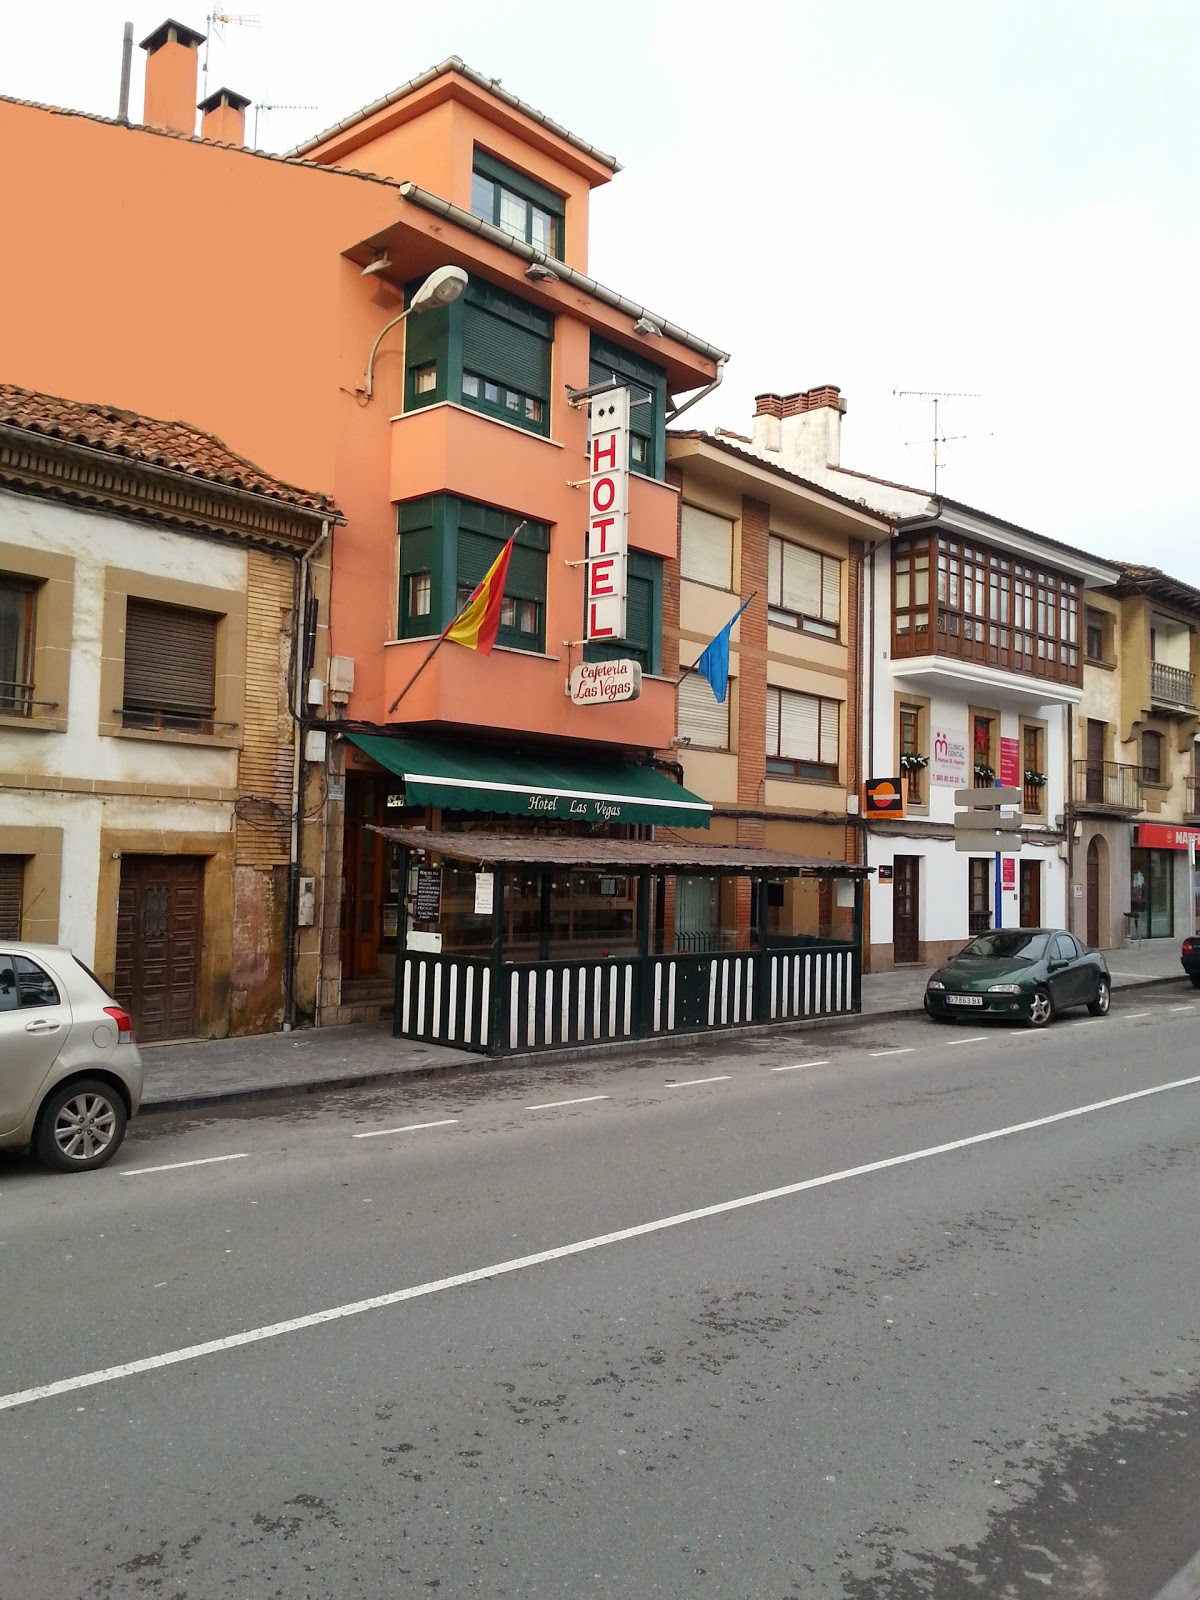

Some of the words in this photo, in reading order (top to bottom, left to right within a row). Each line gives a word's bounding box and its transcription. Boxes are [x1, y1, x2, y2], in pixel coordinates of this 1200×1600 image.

[591, 435, 616, 637] HOTEL
[581, 664, 627, 683] Cafeteria
[574, 680, 597, 698] Las
[600, 676, 630, 700] Vegas
[948, 750, 964, 758] DENTAL
[528, 796, 558, 810] Hotel
[569, 800, 587, 813] Las
[594, 801, 621, 819] Vegas
